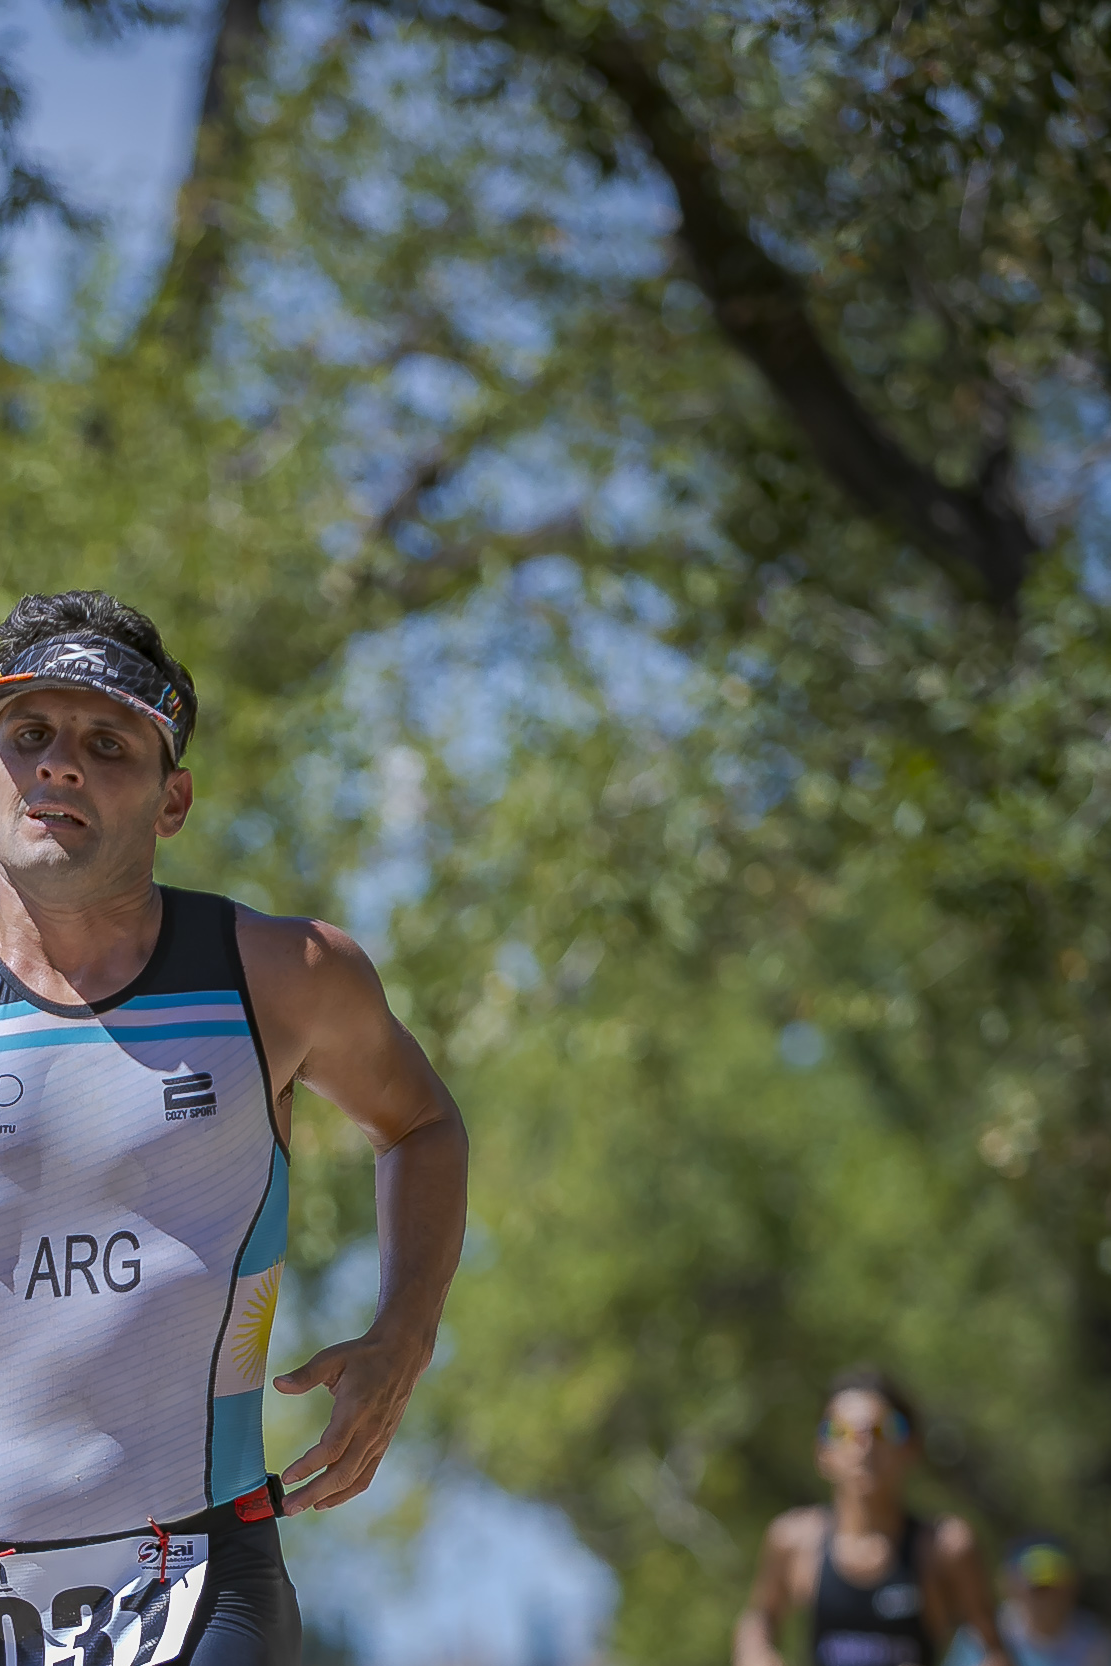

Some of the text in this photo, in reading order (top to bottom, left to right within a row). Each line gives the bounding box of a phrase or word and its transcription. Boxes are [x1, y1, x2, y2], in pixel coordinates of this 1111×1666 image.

[164, 1105, 218, 1121] COZY SPORT
[0, 1124, 17, 1134] ITU
[24, 1229, 141, 1300] ARG
